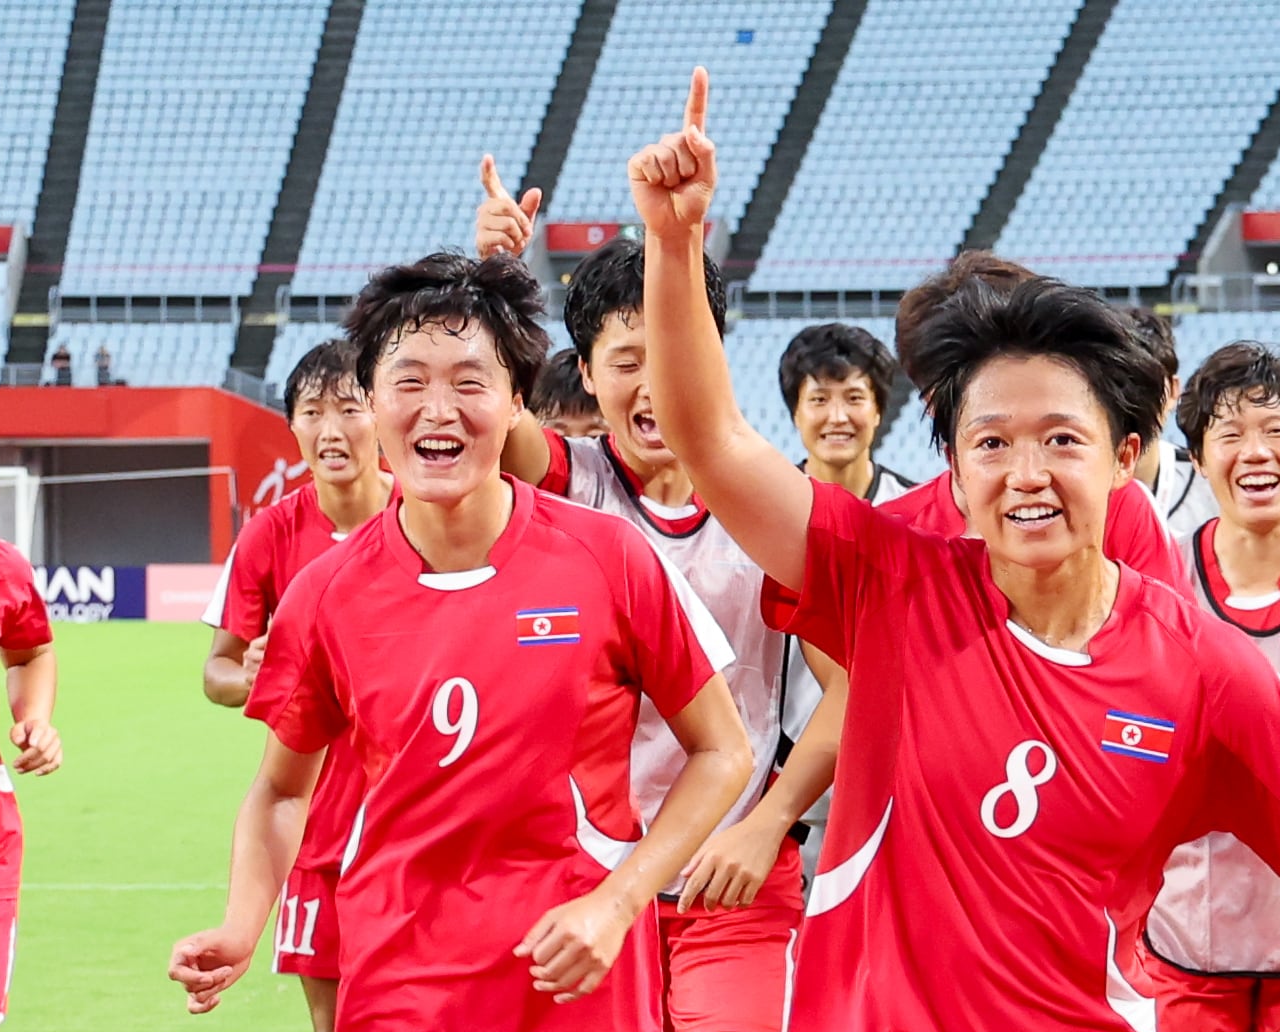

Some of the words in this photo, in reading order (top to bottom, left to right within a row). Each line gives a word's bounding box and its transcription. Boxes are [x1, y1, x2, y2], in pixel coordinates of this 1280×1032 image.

[431, 675, 479, 768] 9
[979, 738, 1058, 839] 8
[279, 894, 320, 956] 11
